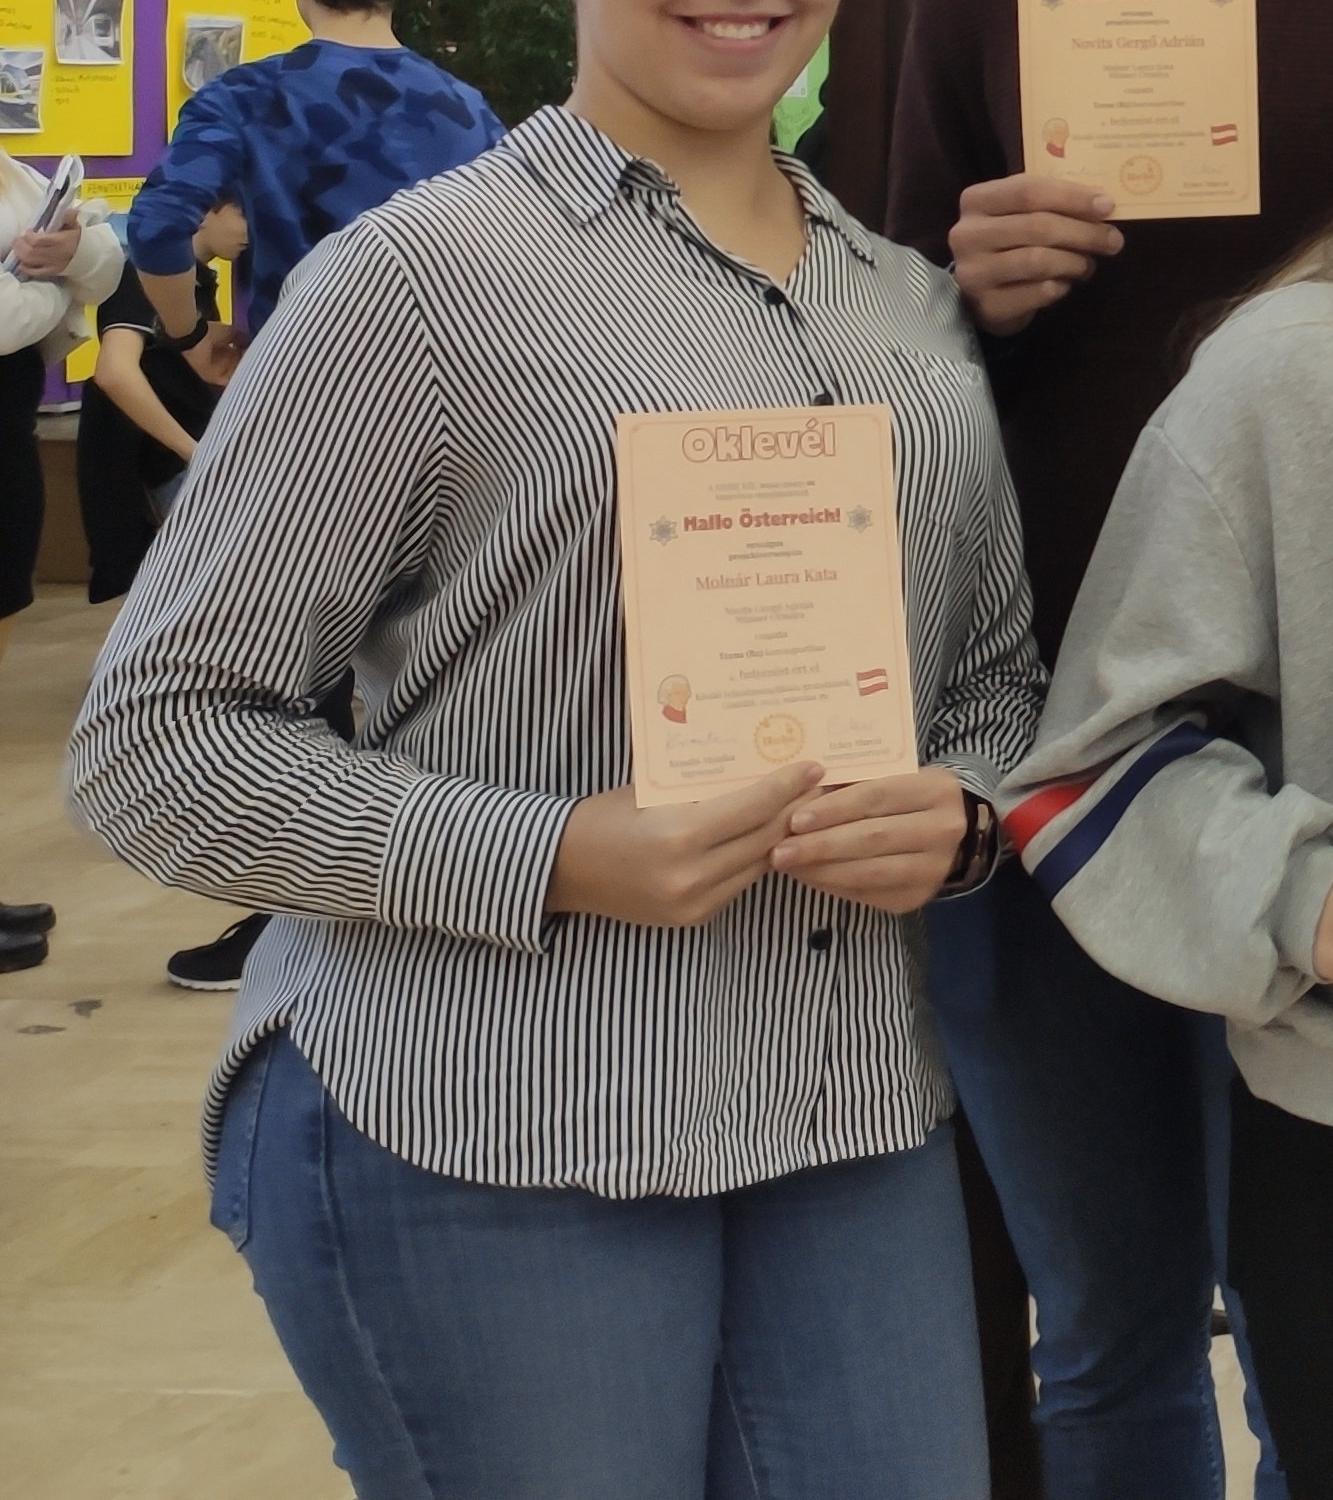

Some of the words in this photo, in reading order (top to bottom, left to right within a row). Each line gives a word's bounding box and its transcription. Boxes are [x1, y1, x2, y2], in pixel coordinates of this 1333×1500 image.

[682, 417, 837, 462] Oklevél
[684, 514, 733, 532] Hallo
[739, 507, 841, 528] Österreich!
[756, 572, 799, 586] Laura
[804, 569, 837, 582] Kata
